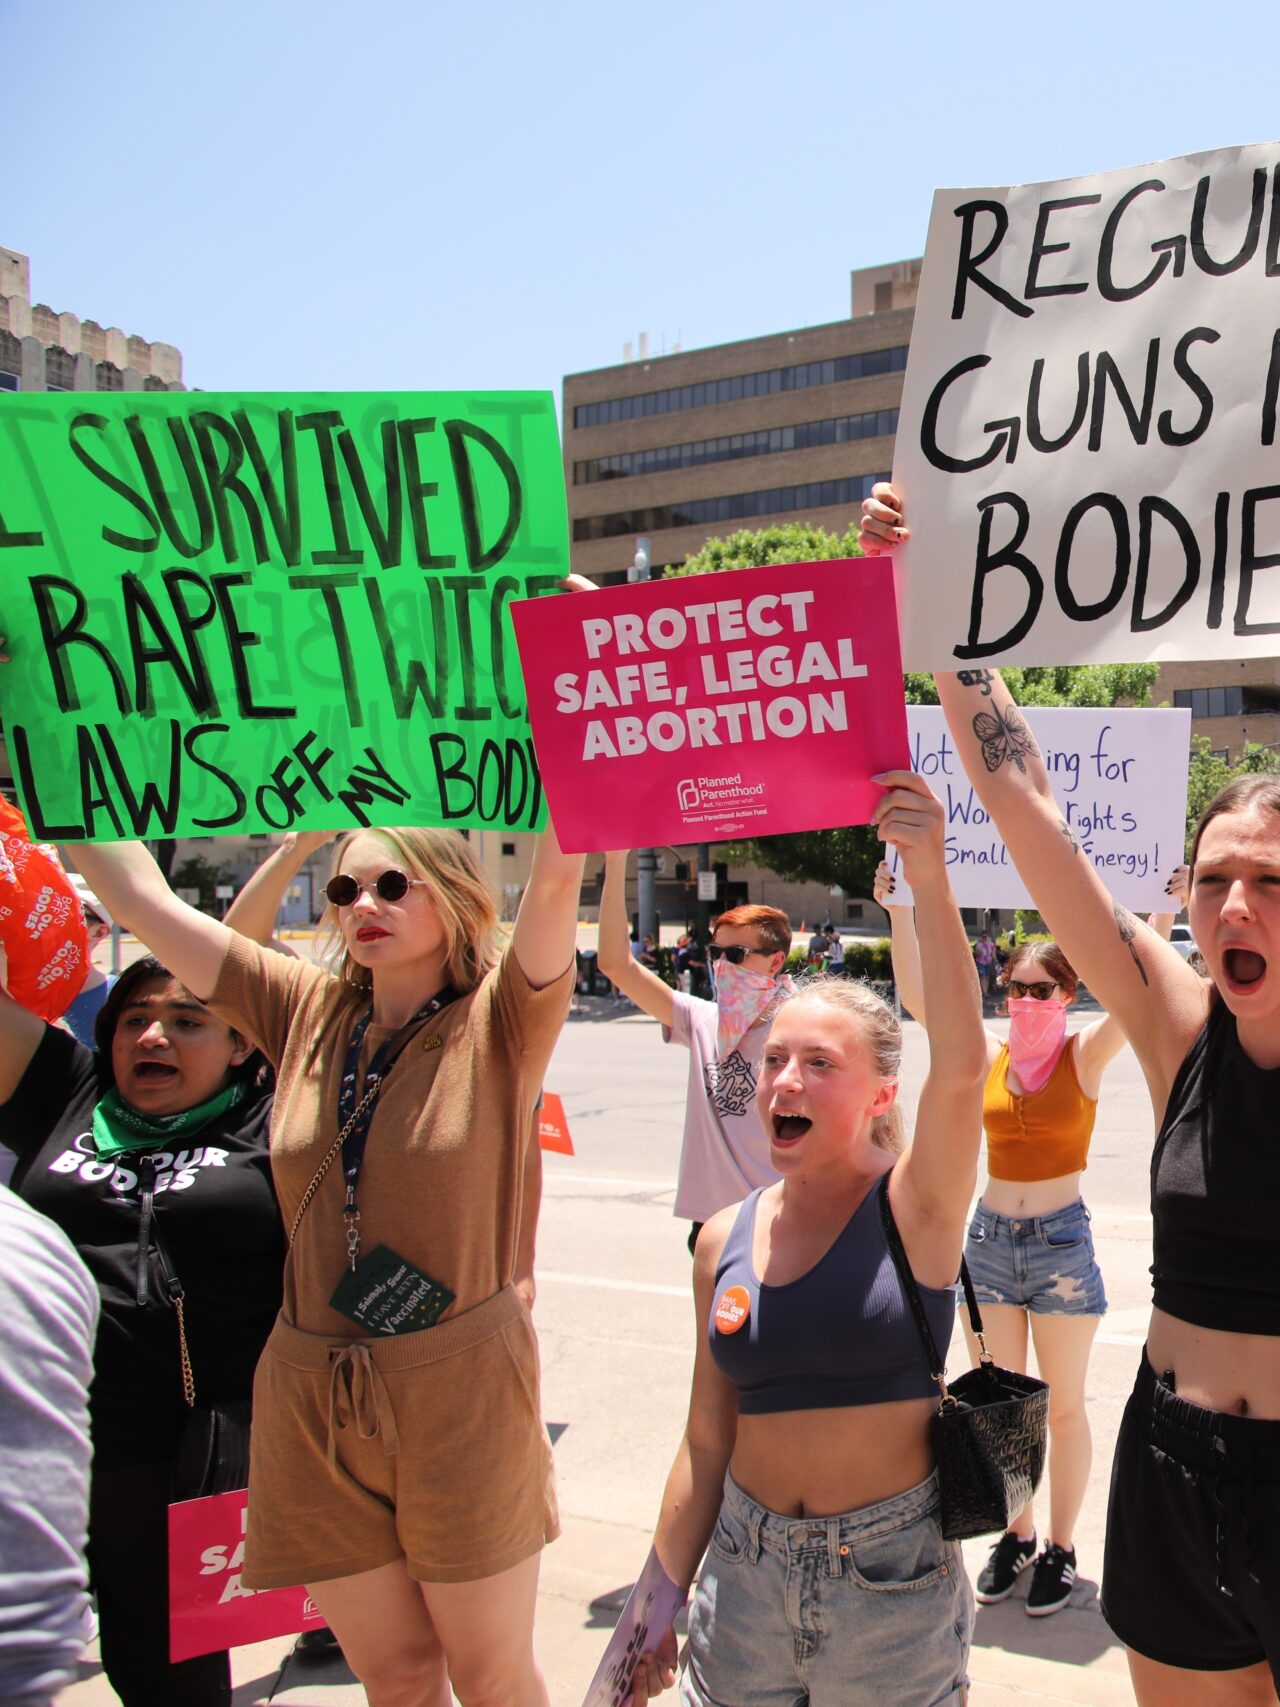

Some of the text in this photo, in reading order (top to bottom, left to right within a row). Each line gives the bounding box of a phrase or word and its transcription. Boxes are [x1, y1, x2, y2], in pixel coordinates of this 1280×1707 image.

[920, 327, 1220, 473] GUNS
[68, 409, 522, 573] SURVIVED
[28, 568, 563, 728] RAPE TWIC
[582, 590, 814, 659] PROTECT
[554, 638, 868, 714] SAFE, LEGAL
[582, 690, 848, 761] ABORTION
[1090, 726, 1135, 782] for
[12, 718, 248, 842] LAWS
[254, 730, 335, 830] OFF
[336, 747, 411, 828] MY
[698, 773, 741, 788] Planned
[700, 784, 763, 800] Parenthood
[1067, 801, 1137, 838] rights
[48, 1149, 200, 1196] BODES
[380, 1279, 432, 1334] Vaccinated
